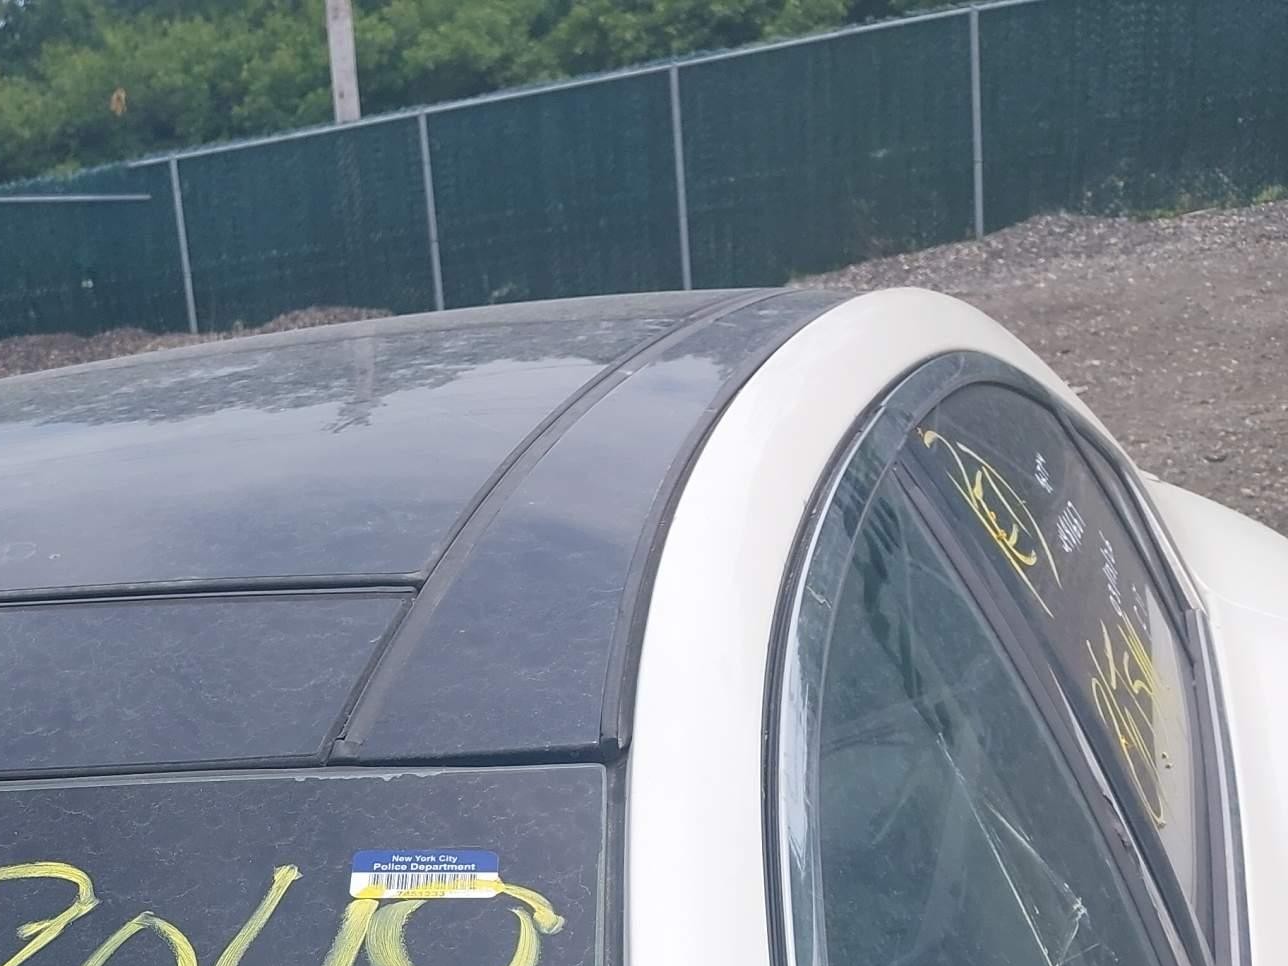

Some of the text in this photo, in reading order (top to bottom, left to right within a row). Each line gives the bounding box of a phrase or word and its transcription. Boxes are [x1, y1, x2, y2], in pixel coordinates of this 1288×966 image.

[439, 855, 458, 864] City
[373, 863, 476, 872] Police Department
